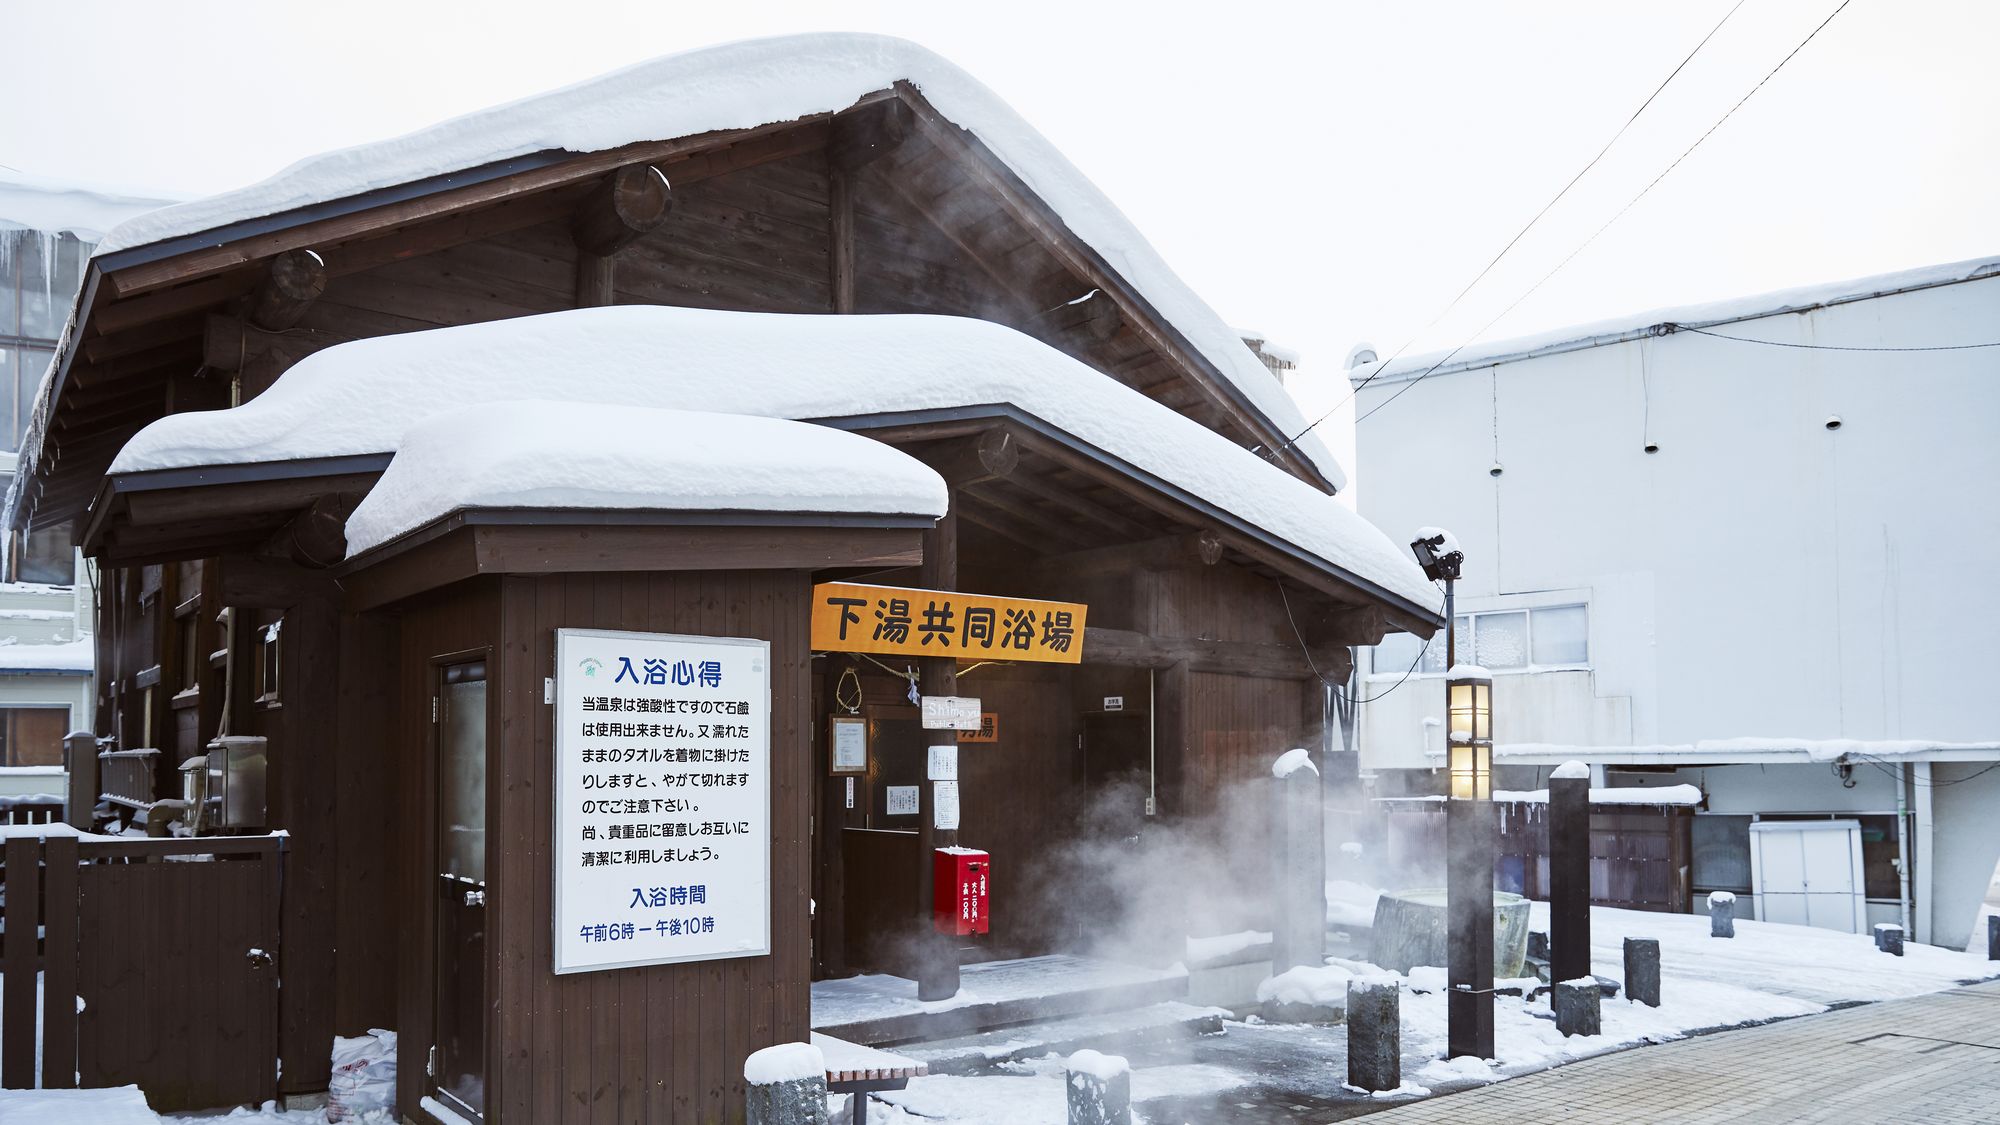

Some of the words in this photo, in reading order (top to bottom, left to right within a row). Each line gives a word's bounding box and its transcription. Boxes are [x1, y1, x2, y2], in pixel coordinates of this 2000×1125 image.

[827, 597, 1074, 653] 下湯共同浴場
[614, 656, 722, 688] 入浴心得
[582, 722, 750, 739] は使用出来ません。又濡れた
[581, 748, 750, 763] ままのタオルを着物に掛けた
[582, 772, 750, 790] りしますと、やがて切れます
[581, 798, 700, 814] のでご注意下さい。
[582, 821, 750, 841] 尚、貴重品に留意しお互いに
[581, 846, 720, 867] 清潔に利用しましょう。
[629, 884, 706, 909] 入浴時間
